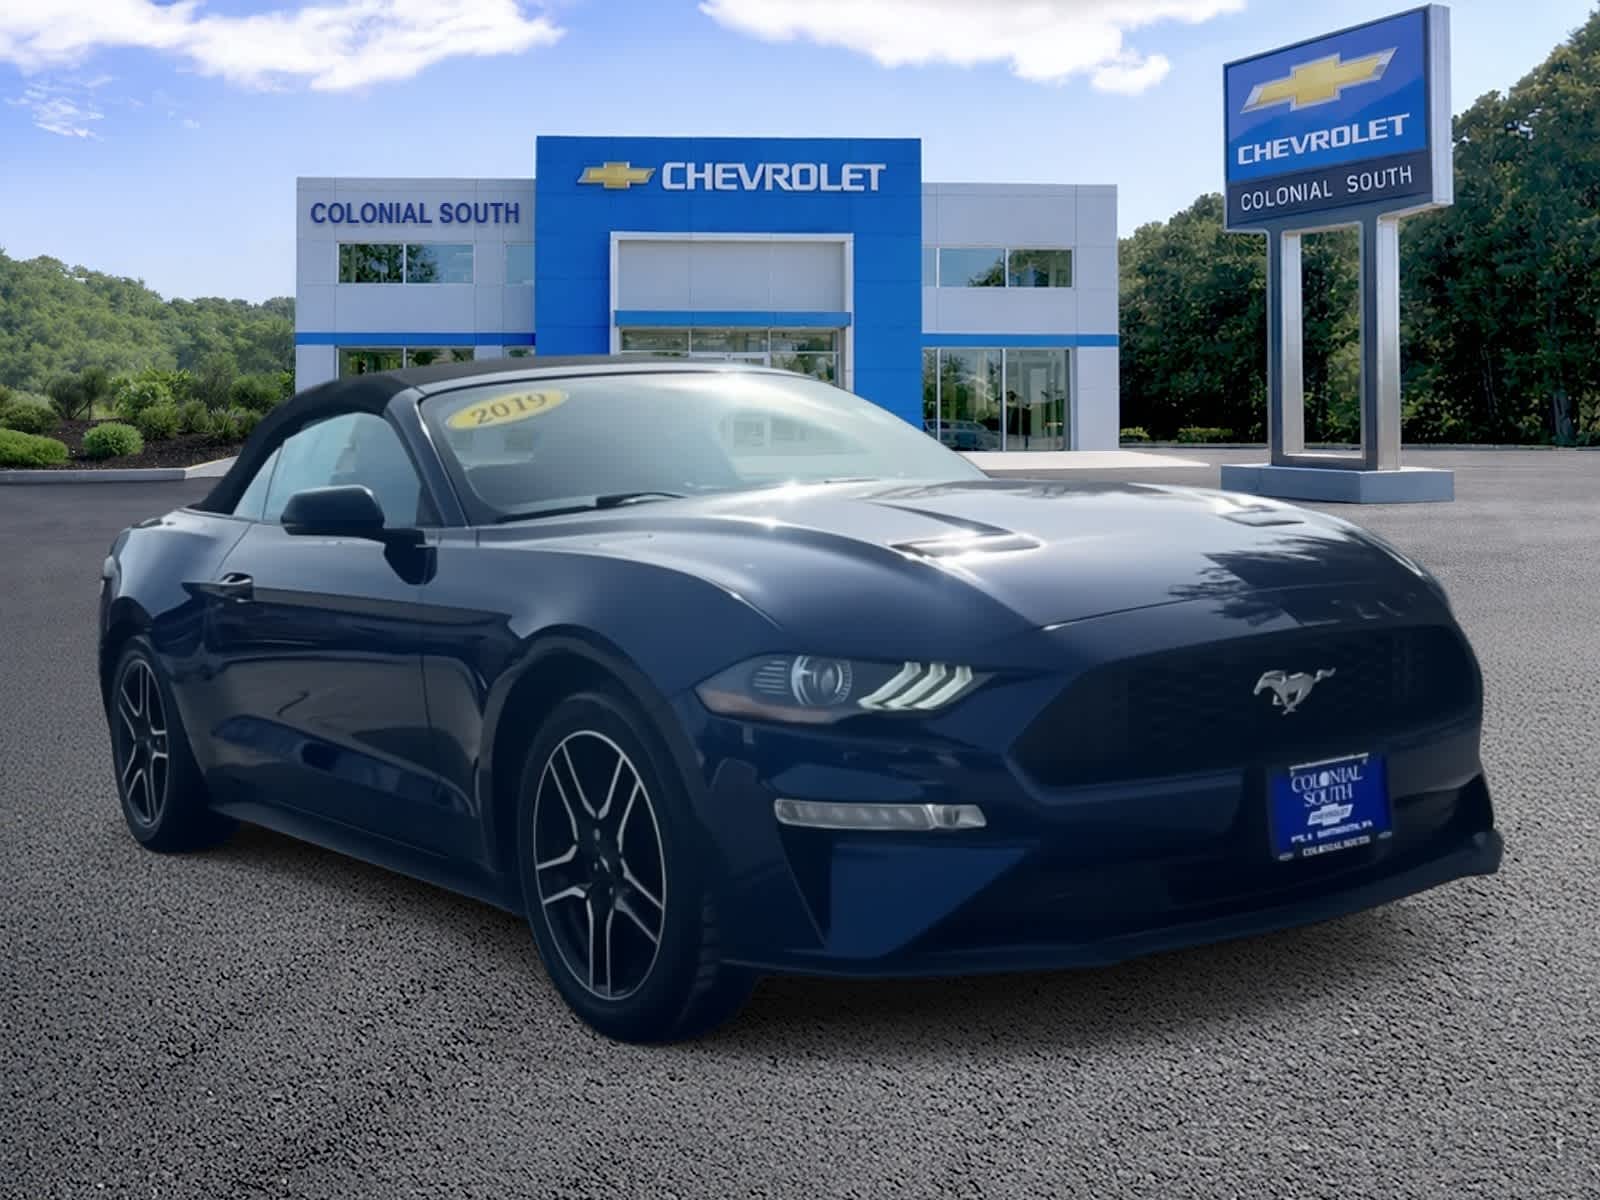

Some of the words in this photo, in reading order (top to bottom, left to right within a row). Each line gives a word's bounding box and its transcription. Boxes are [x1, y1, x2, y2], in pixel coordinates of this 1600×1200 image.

[1238, 113, 1410, 165] CHEVROLET
[661, 161, 887, 191] CHEVROLET
[1240, 179, 1333, 211] COLONIAL
[1346, 164, 1413, 193] SOUTH
[310, 202, 433, 224] COLONIAL
[439, 202, 520, 224] SOUTH
[470, 391, 546, 424] 2019
[1291, 765, 1364, 793] COLONIAL
[1303, 783, 1353, 808] SOUTH
